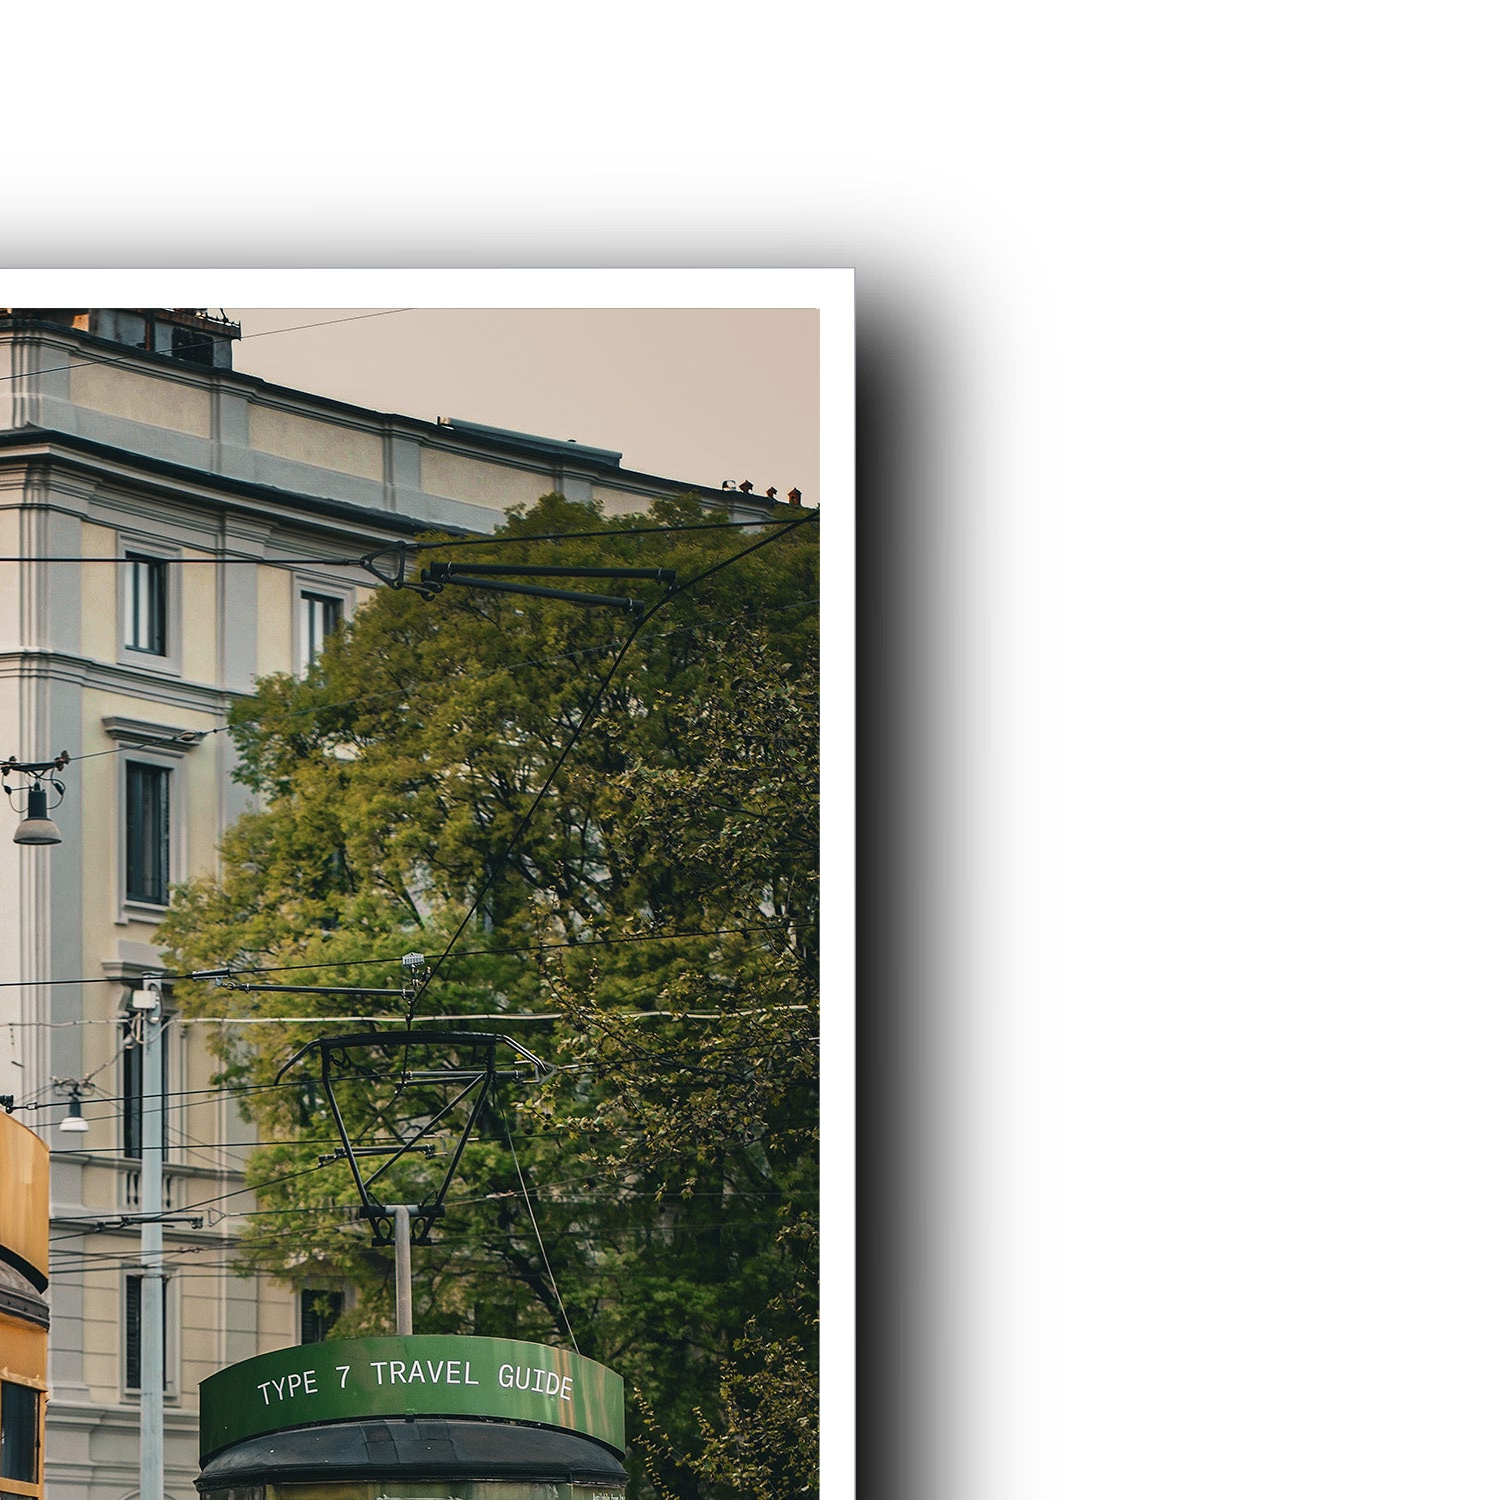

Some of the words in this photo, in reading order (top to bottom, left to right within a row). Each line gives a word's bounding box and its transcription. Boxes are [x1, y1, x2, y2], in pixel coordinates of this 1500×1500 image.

[257, 1369, 318, 1406] TYPE
[335, 1365, 351, 1389] 7
[369, 1360, 480, 1386] TRAVEL
[498, 1363, 575, 1401] GUIDE
